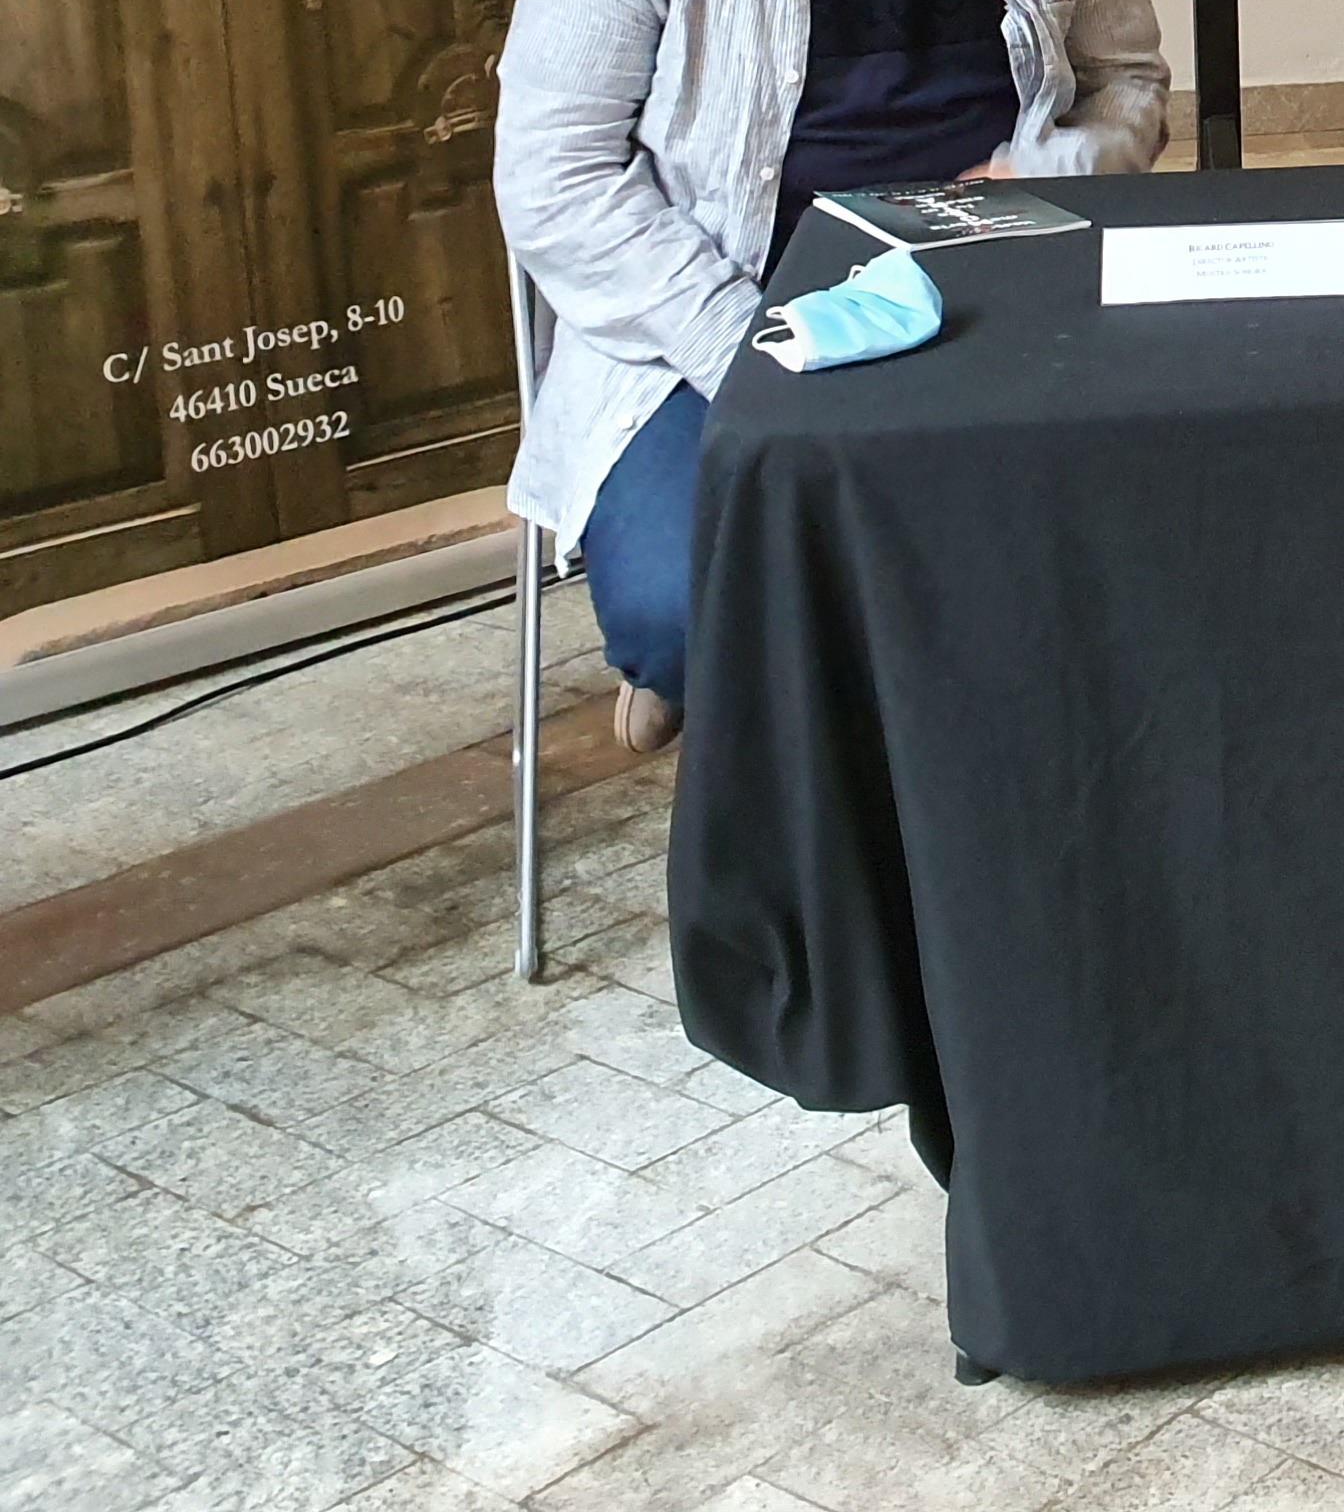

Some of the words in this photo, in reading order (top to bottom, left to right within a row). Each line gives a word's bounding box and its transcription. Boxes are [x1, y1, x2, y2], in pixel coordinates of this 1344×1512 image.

[102, 347, 148, 384] C/
[162, 335, 235, 371] Sant
[242, 320, 339, 363] Josep,
[346, 296, 405, 332] 8-10
[169, 380, 257, 423] 46410
[266, 366, 359, 402] Sueca
[191, 411, 351, 473] 663002932
